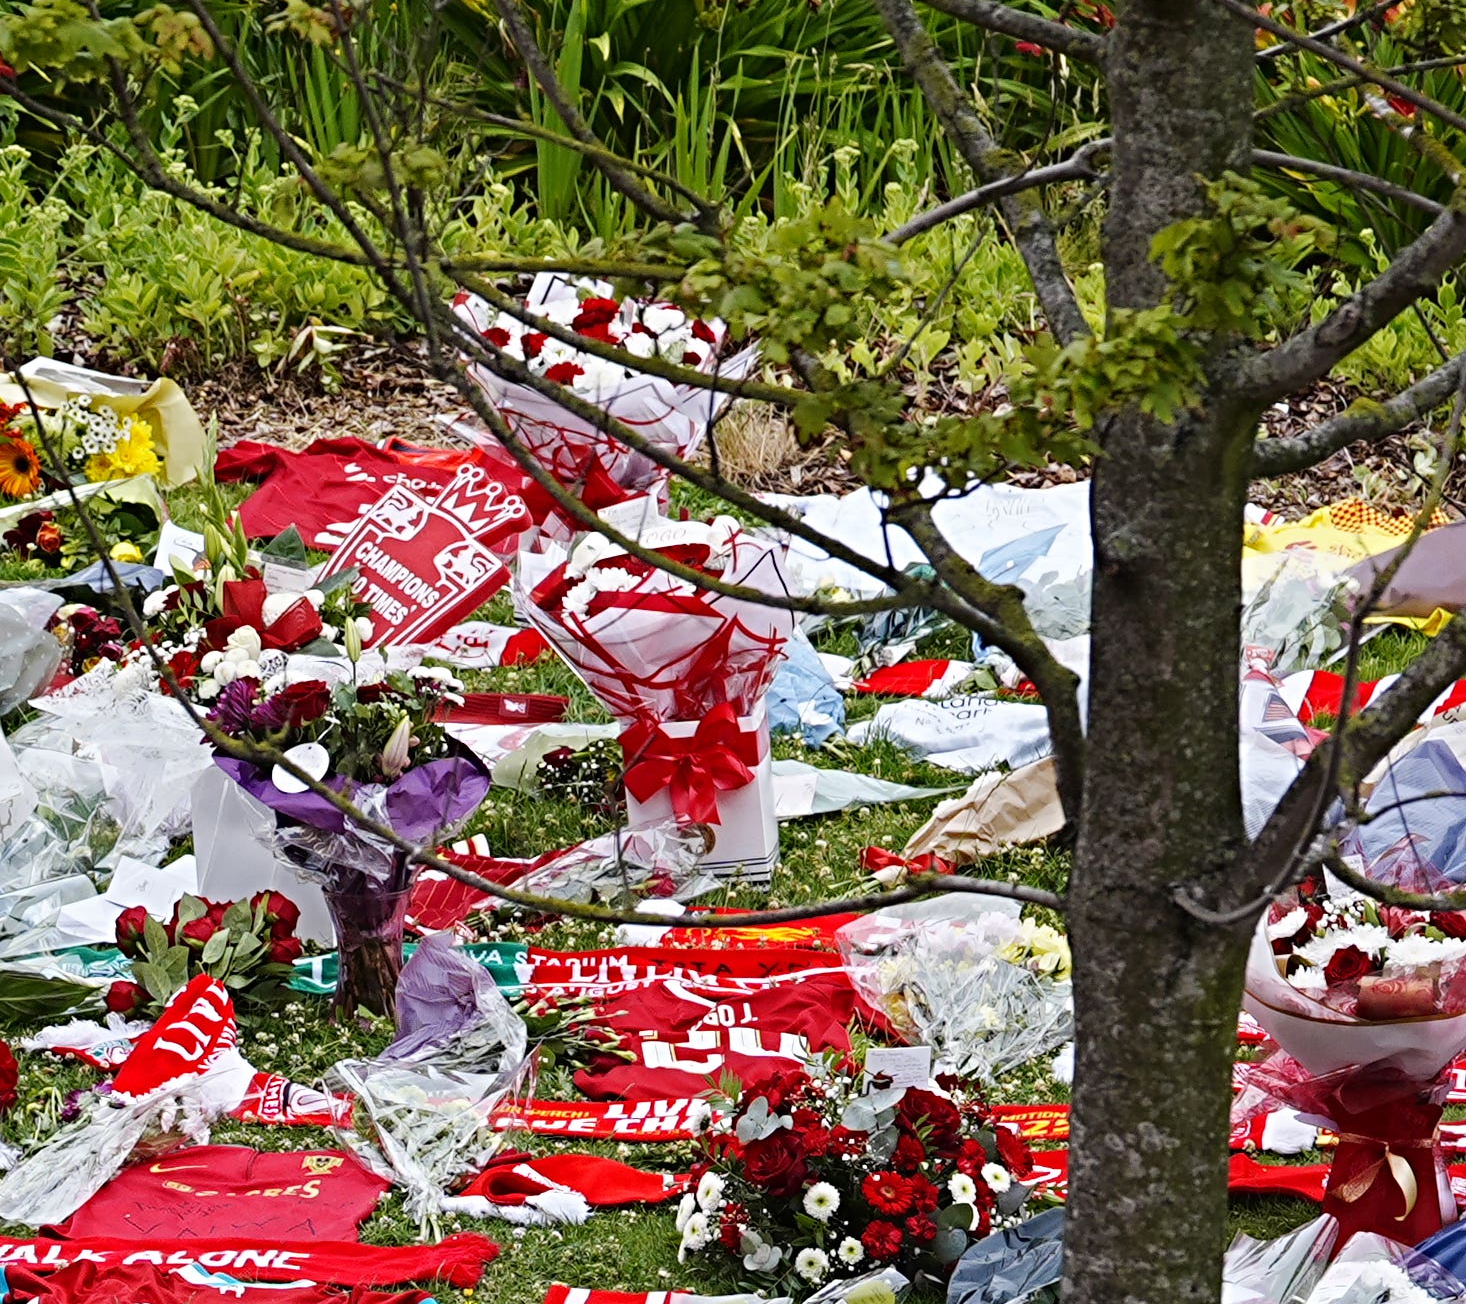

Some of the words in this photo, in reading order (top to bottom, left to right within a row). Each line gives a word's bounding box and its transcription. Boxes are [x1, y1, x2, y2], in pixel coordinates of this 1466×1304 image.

[354, 534, 440, 611] CHAMPIONS
[368, 586, 412, 629] TIMES
[122, 1245, 311, 1274] ALONE
